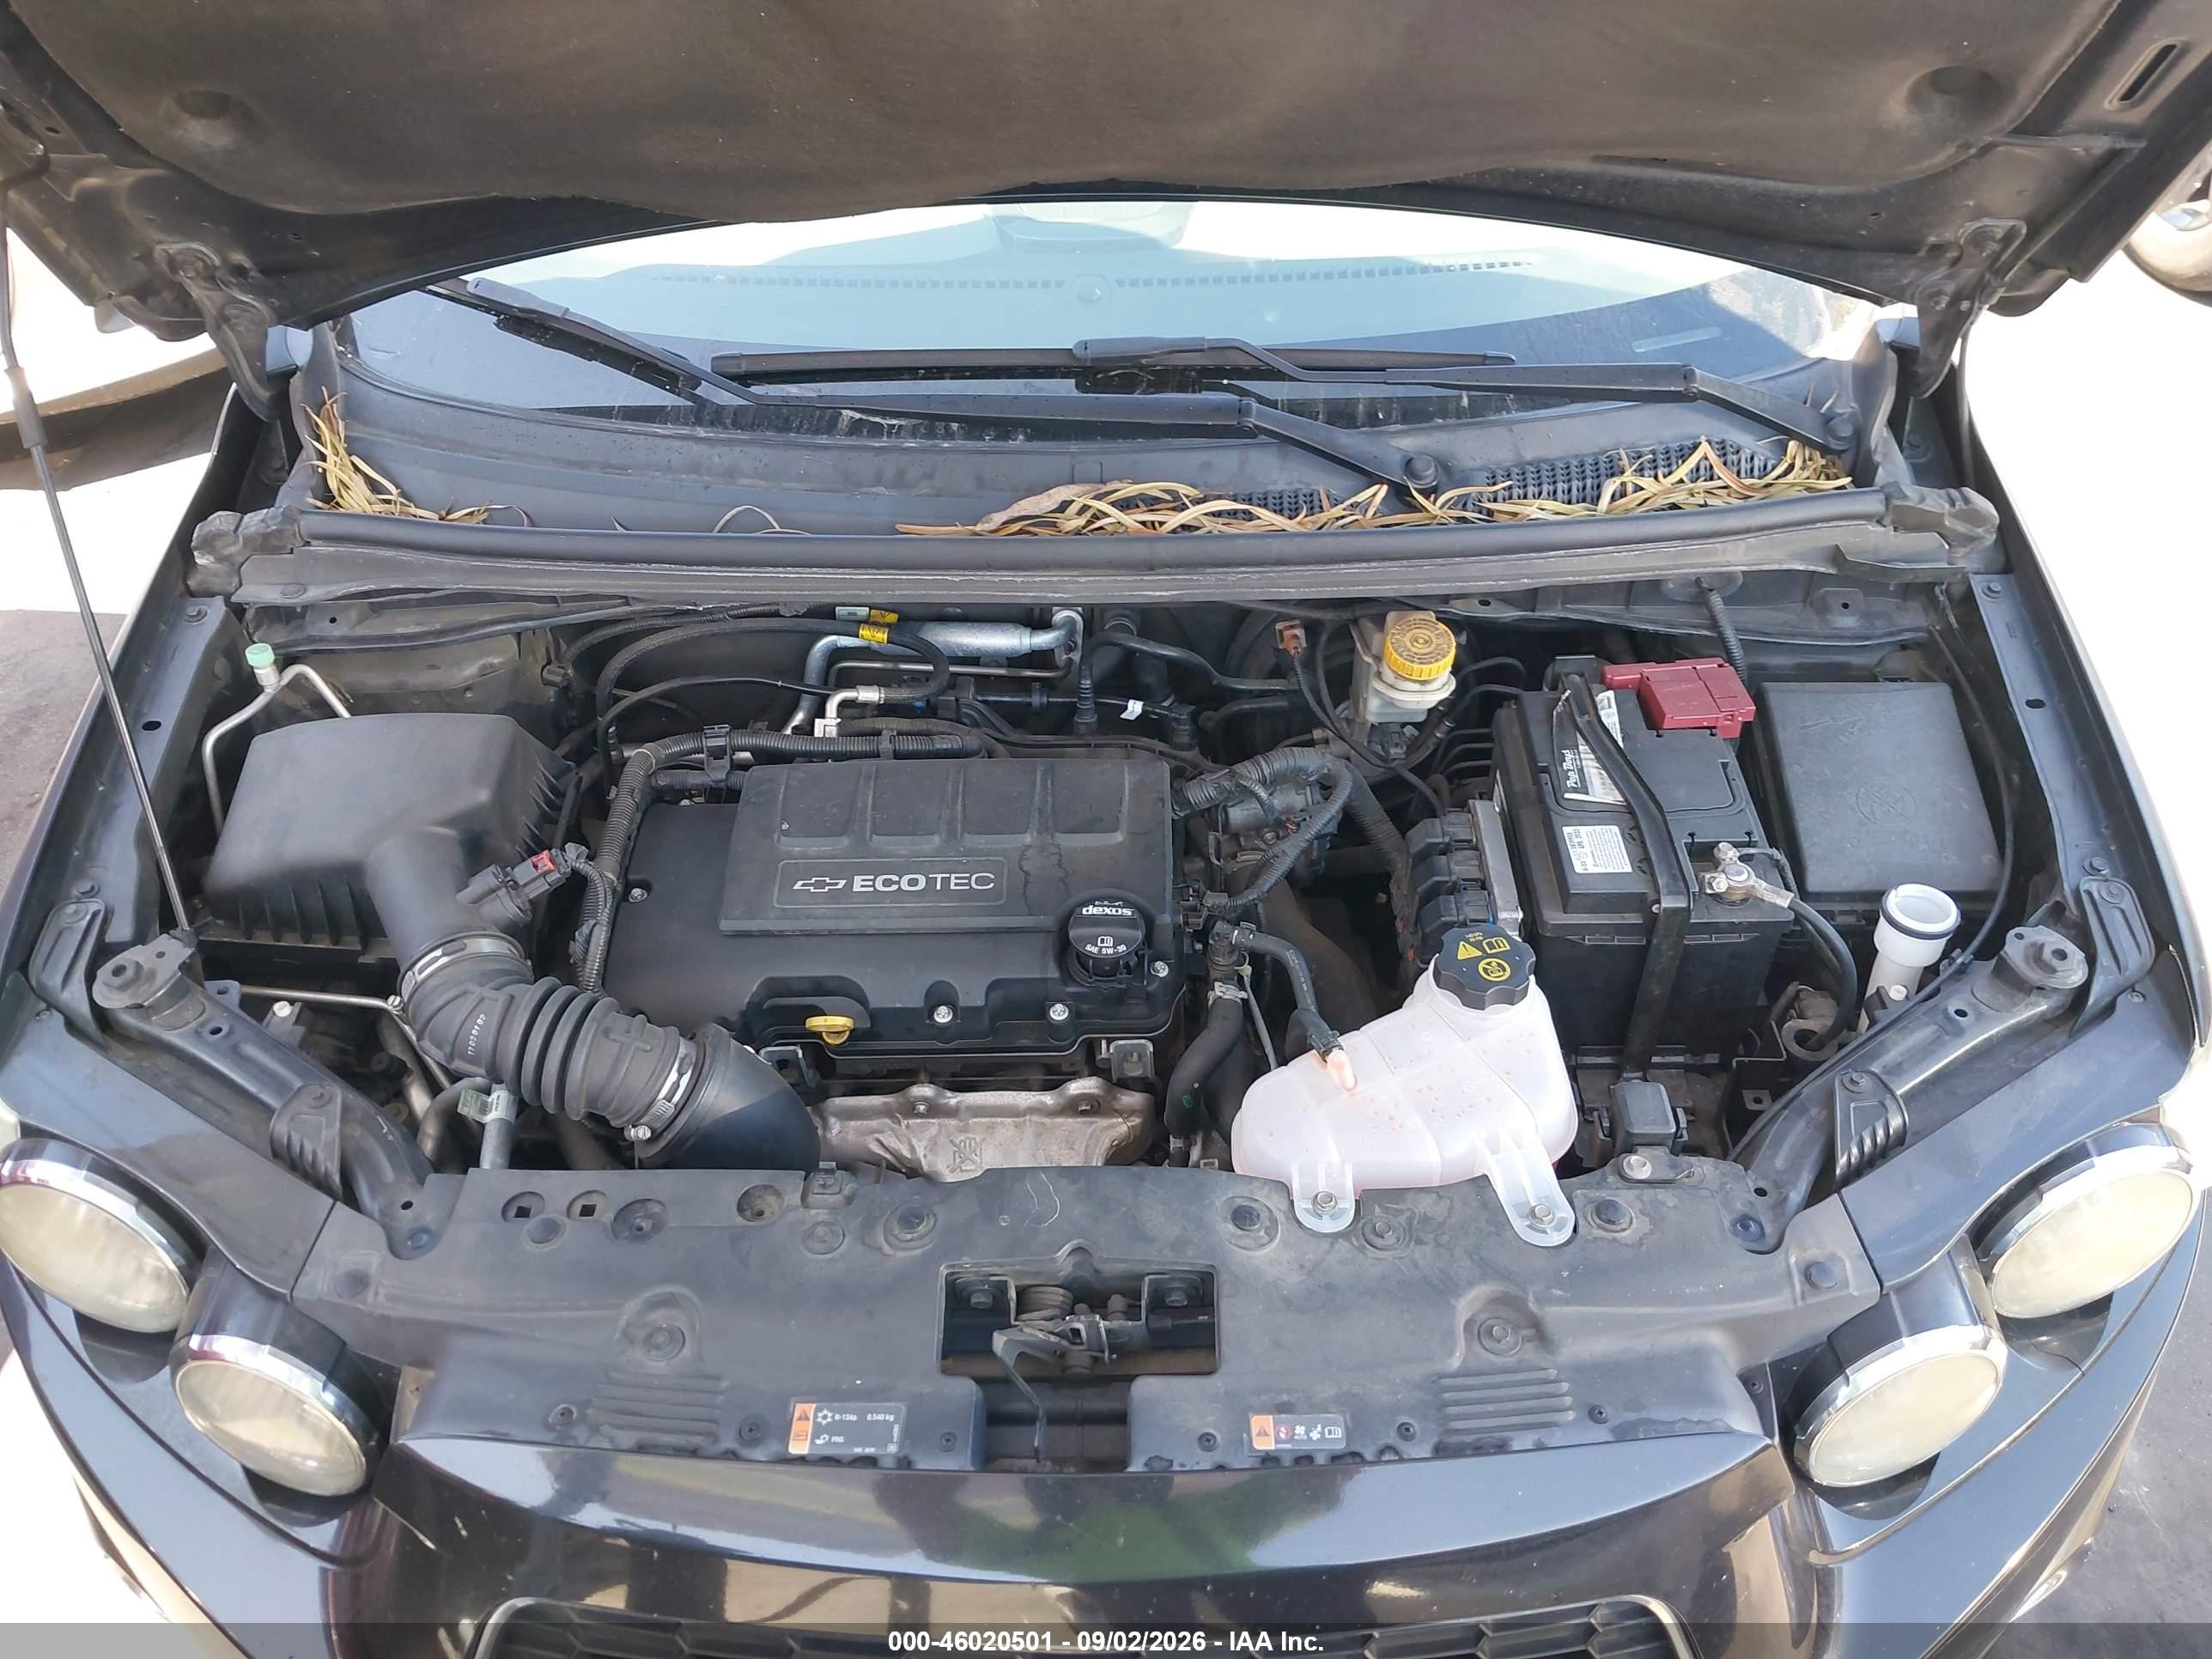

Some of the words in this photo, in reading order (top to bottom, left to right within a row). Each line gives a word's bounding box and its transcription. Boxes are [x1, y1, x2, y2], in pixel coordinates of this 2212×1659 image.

[1561, 749, 1577, 770] Boys
[1565, 771, 1577, 787] Pep
[853, 872, 995, 891] ECOTEC
[1082, 905, 1133, 916] dexos
[1085, 944, 1099, 954] SAE
[1101, 944, 1127, 955] 5W-30
[885, 1413, 895, 1422] kg
